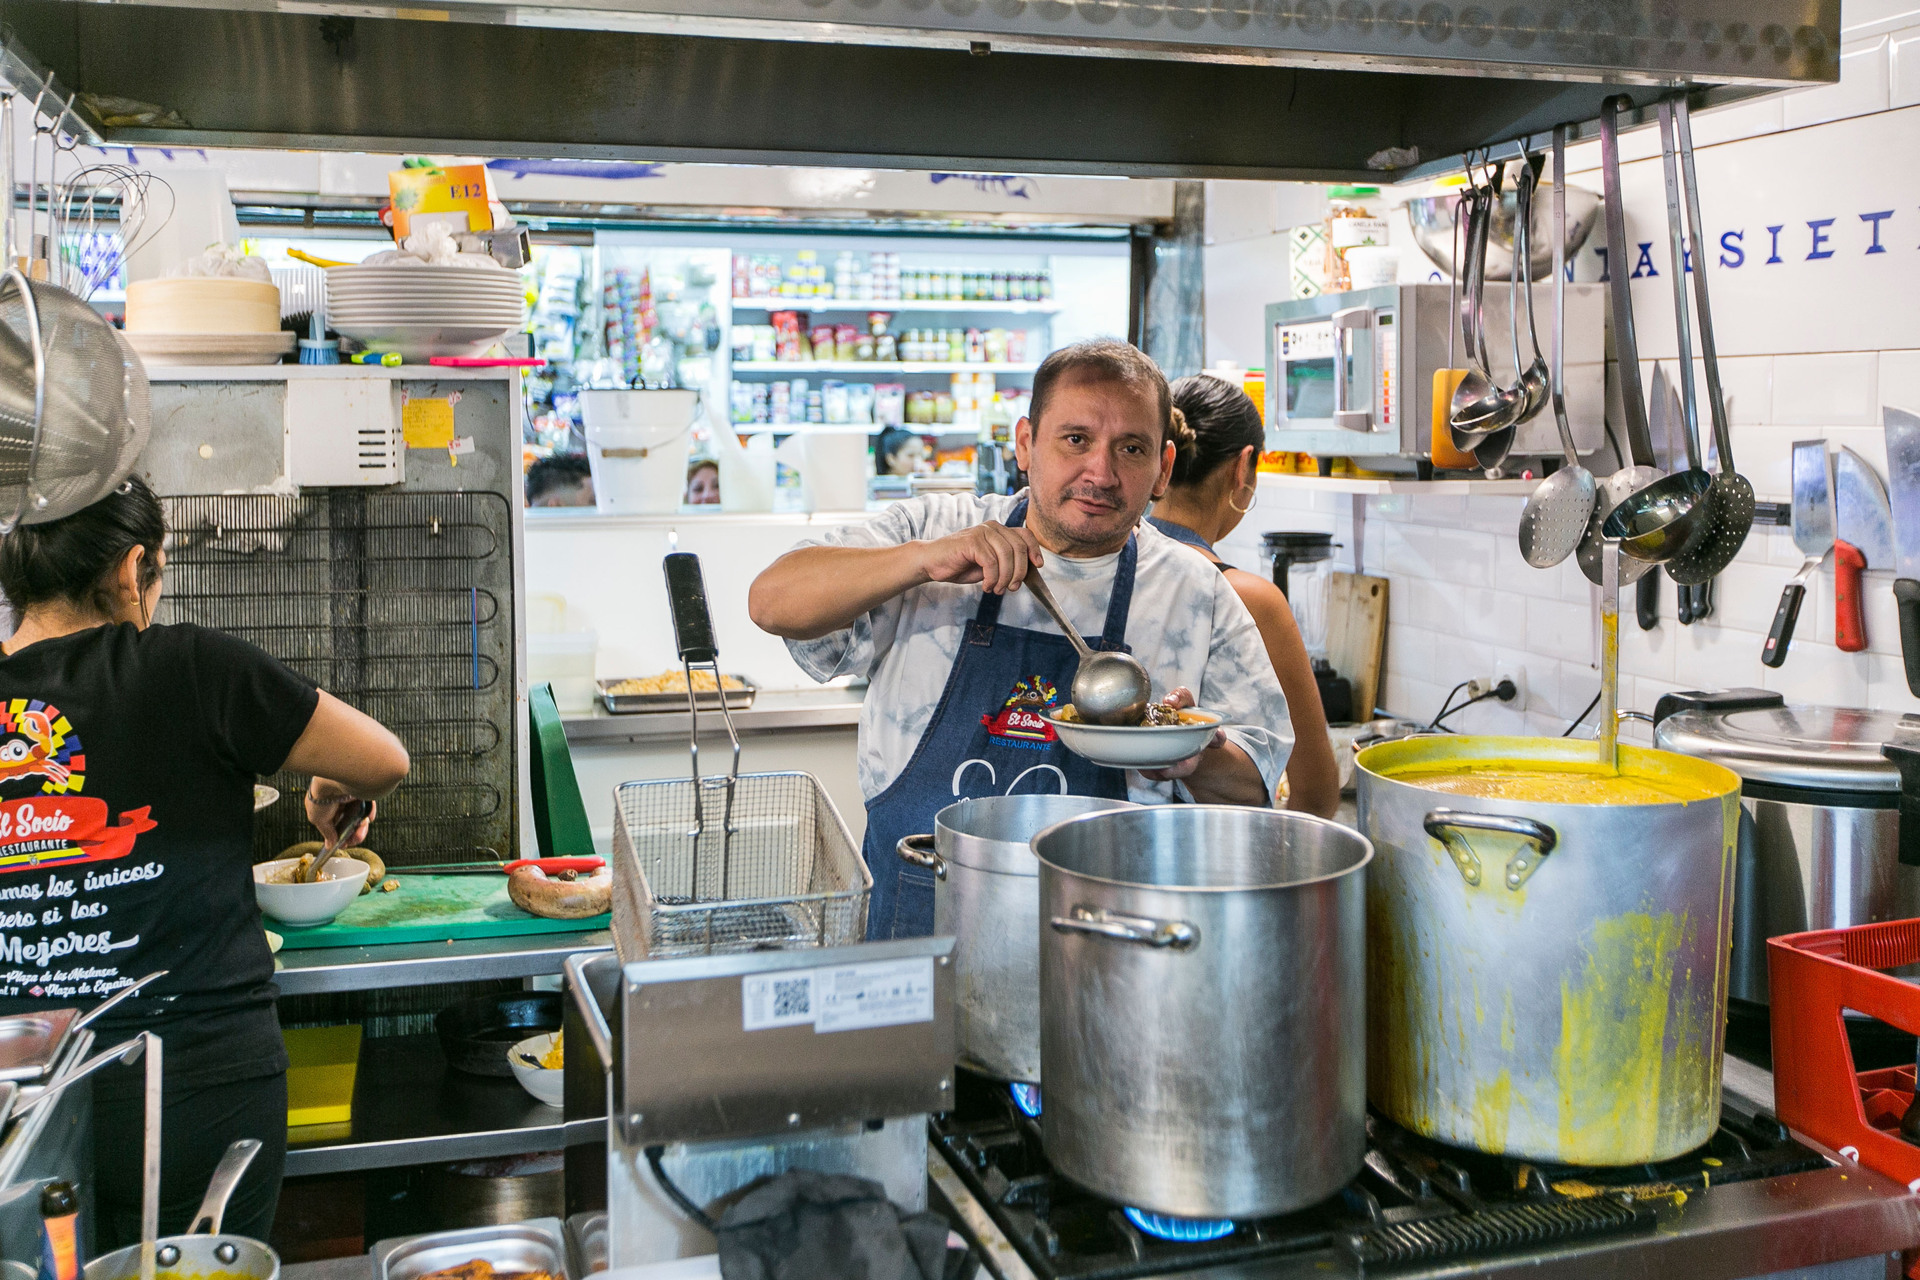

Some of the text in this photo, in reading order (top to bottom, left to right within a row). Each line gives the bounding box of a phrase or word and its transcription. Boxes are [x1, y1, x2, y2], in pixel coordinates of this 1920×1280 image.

[450, 183, 482, 199] E12
[1719, 199, 1920, 269] SIET
[1007, 712, 1046, 729] El Socio
[989, 735, 1052, 751] RESTAURANTE
[0, 803, 75, 839] l Socio
[0, 861, 165, 901] mos los únicos
[41, 906, 63, 926] si
[70, 899, 109, 920] los
[0, 930, 140, 968] Mejores
[39, 970, 53, 983] de
[53, 969, 67, 982] los
[44, 983, 78, 999] Plaza
[78, 981, 92, 994] de
[92, 976, 136, 995] España
